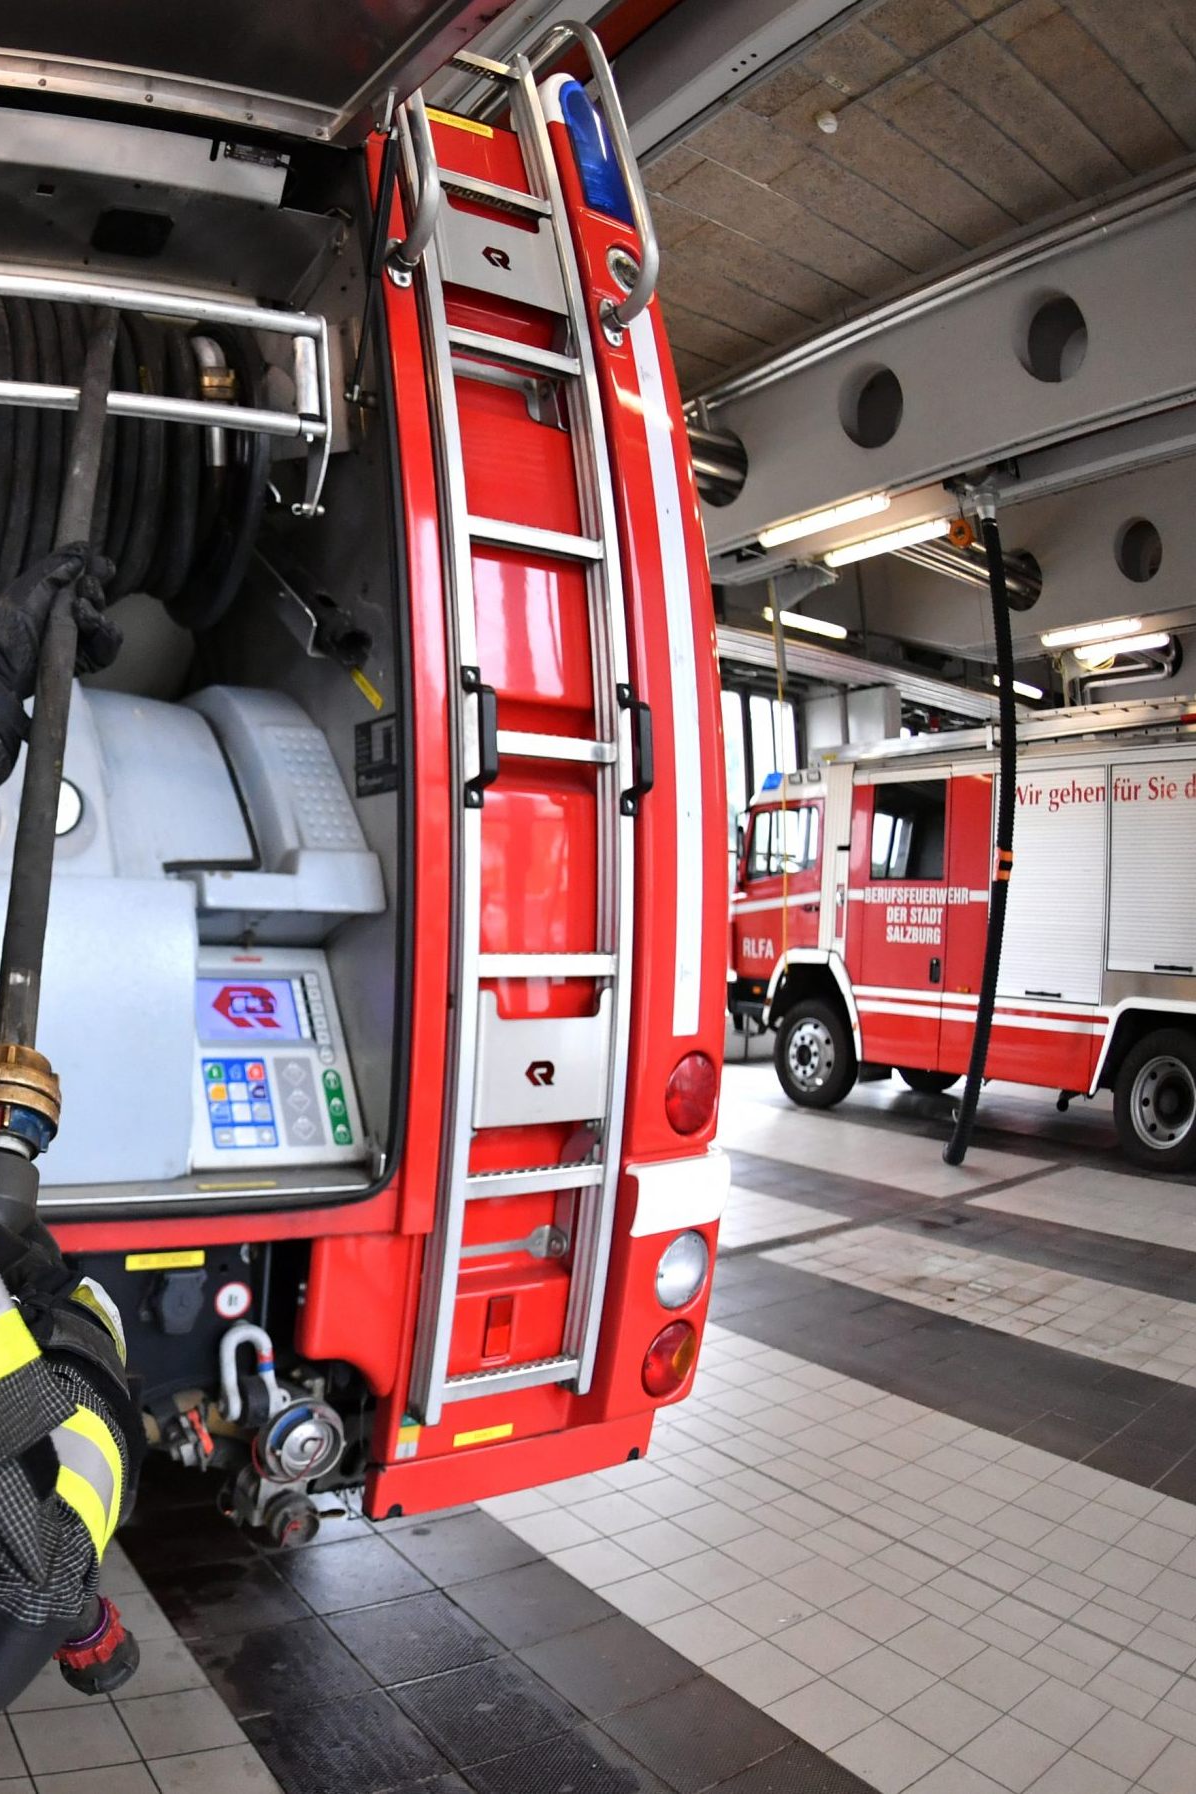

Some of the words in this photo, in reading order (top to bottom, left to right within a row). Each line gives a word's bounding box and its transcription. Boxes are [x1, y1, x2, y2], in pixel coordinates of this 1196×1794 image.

[1048, 780, 1106, 813] gehen
[1112, 777, 1142, 802] für
[1148, 776, 1177, 801] Sie
[864, 886, 969, 905] BERUFSFEUERWEHR
[886, 905, 907, 924] DER
[910, 907, 943, 925] STADT
[886, 924, 941, 945] SALZBURG
[742, 936, 774, 960] RLFA
